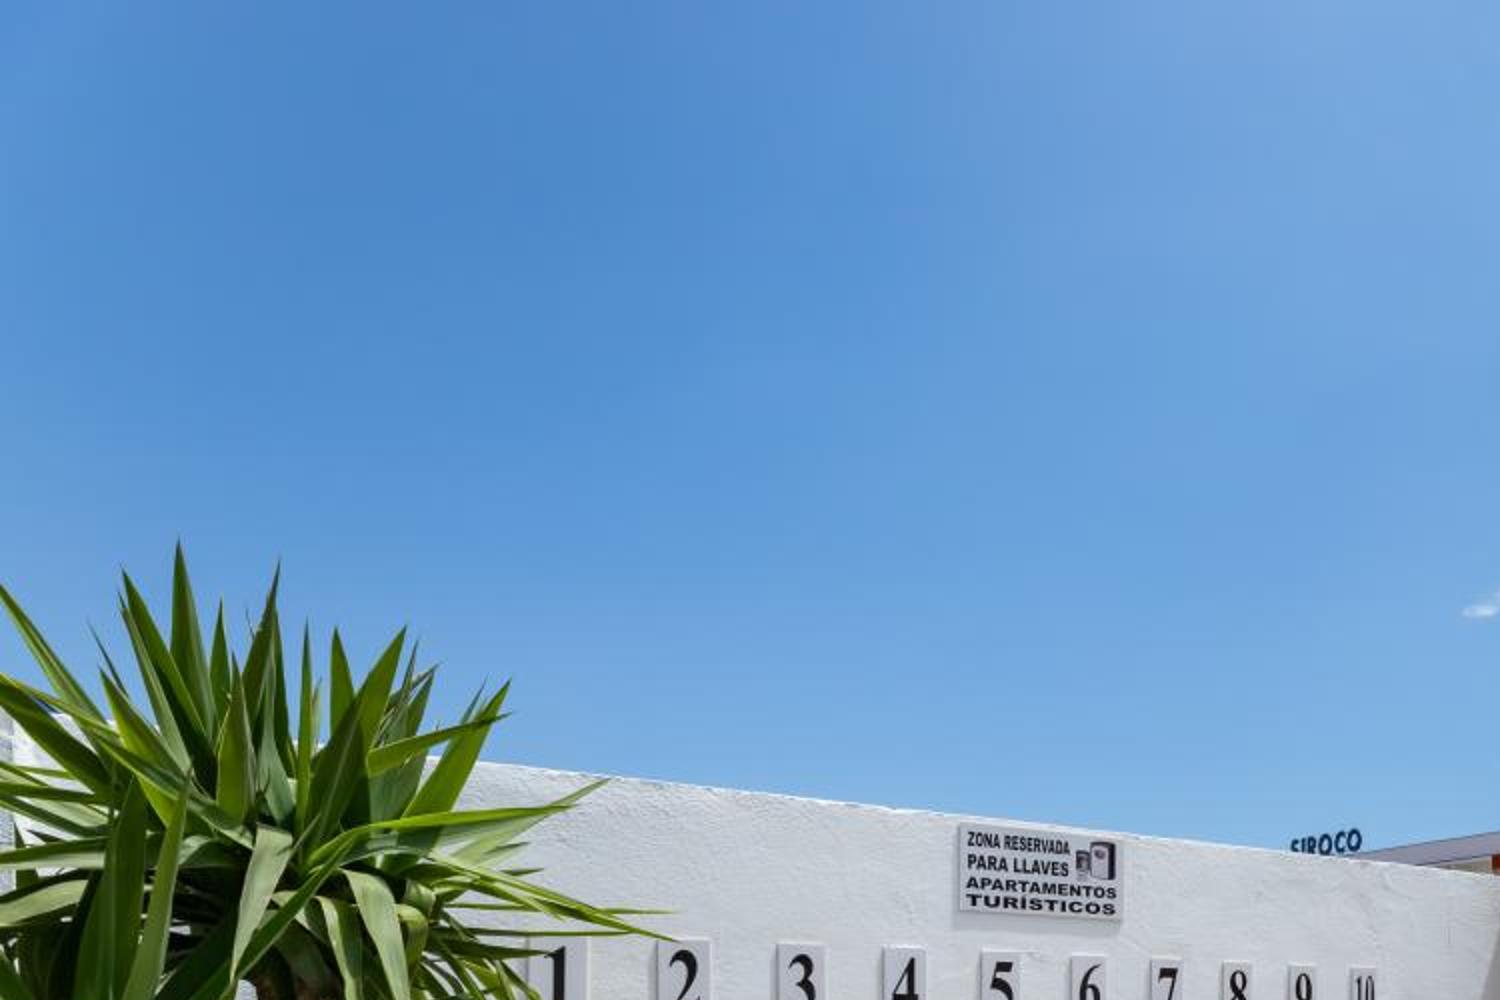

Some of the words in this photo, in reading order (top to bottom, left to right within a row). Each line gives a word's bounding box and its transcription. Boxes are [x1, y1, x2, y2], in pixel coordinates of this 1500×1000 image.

[967, 831, 1001, 849] ZONA
[1004, 835, 1070, 855] RESERVADA
[967, 853, 1008, 872] PARA
[1013, 858, 1069, 877] LLAVES
[966, 876, 1117, 899] APARTAMENTOS
[965, 893, 1116, 915] TURÍSTICOS
